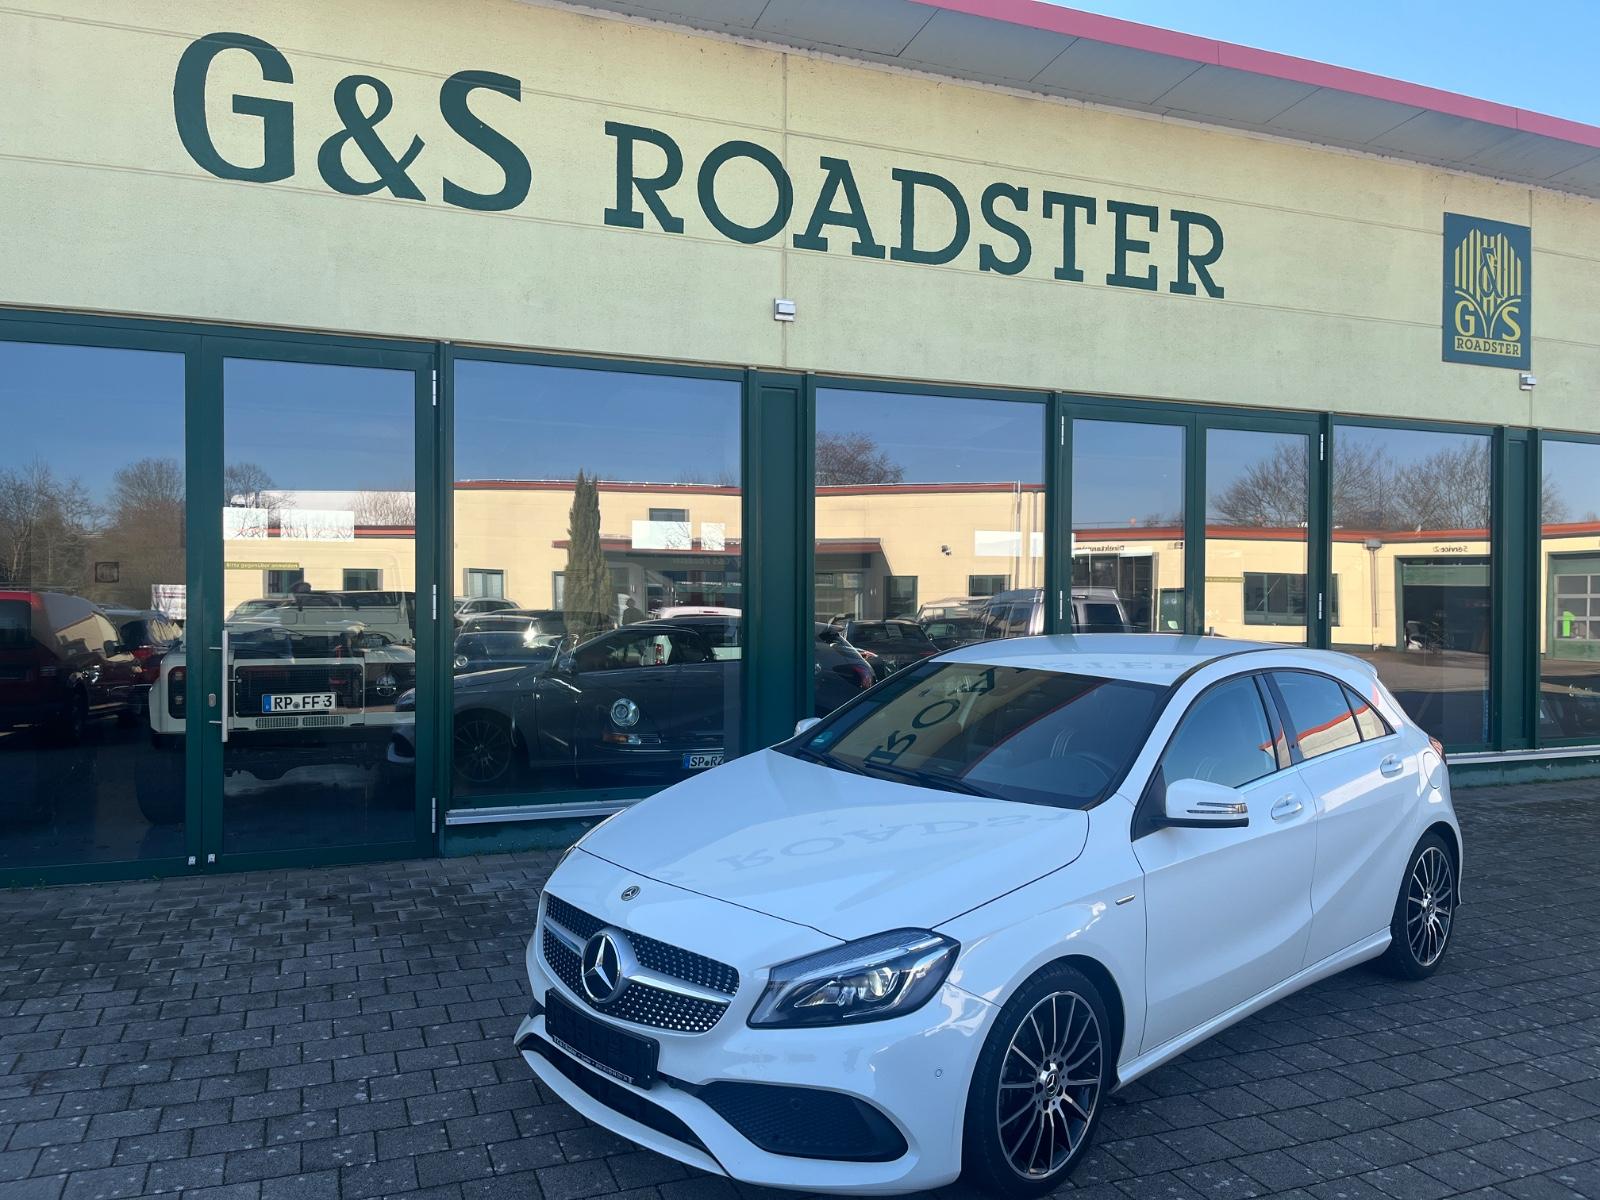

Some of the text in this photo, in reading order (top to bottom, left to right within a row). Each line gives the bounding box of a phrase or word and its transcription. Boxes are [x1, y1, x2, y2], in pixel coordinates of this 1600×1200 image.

[173, 31, 1225, 299] G&S ROADSTER
[1456, 337, 1520, 356] ROADSTER
[274, 697, 293, 710] RP
[691, 757, 705, 767] SP
